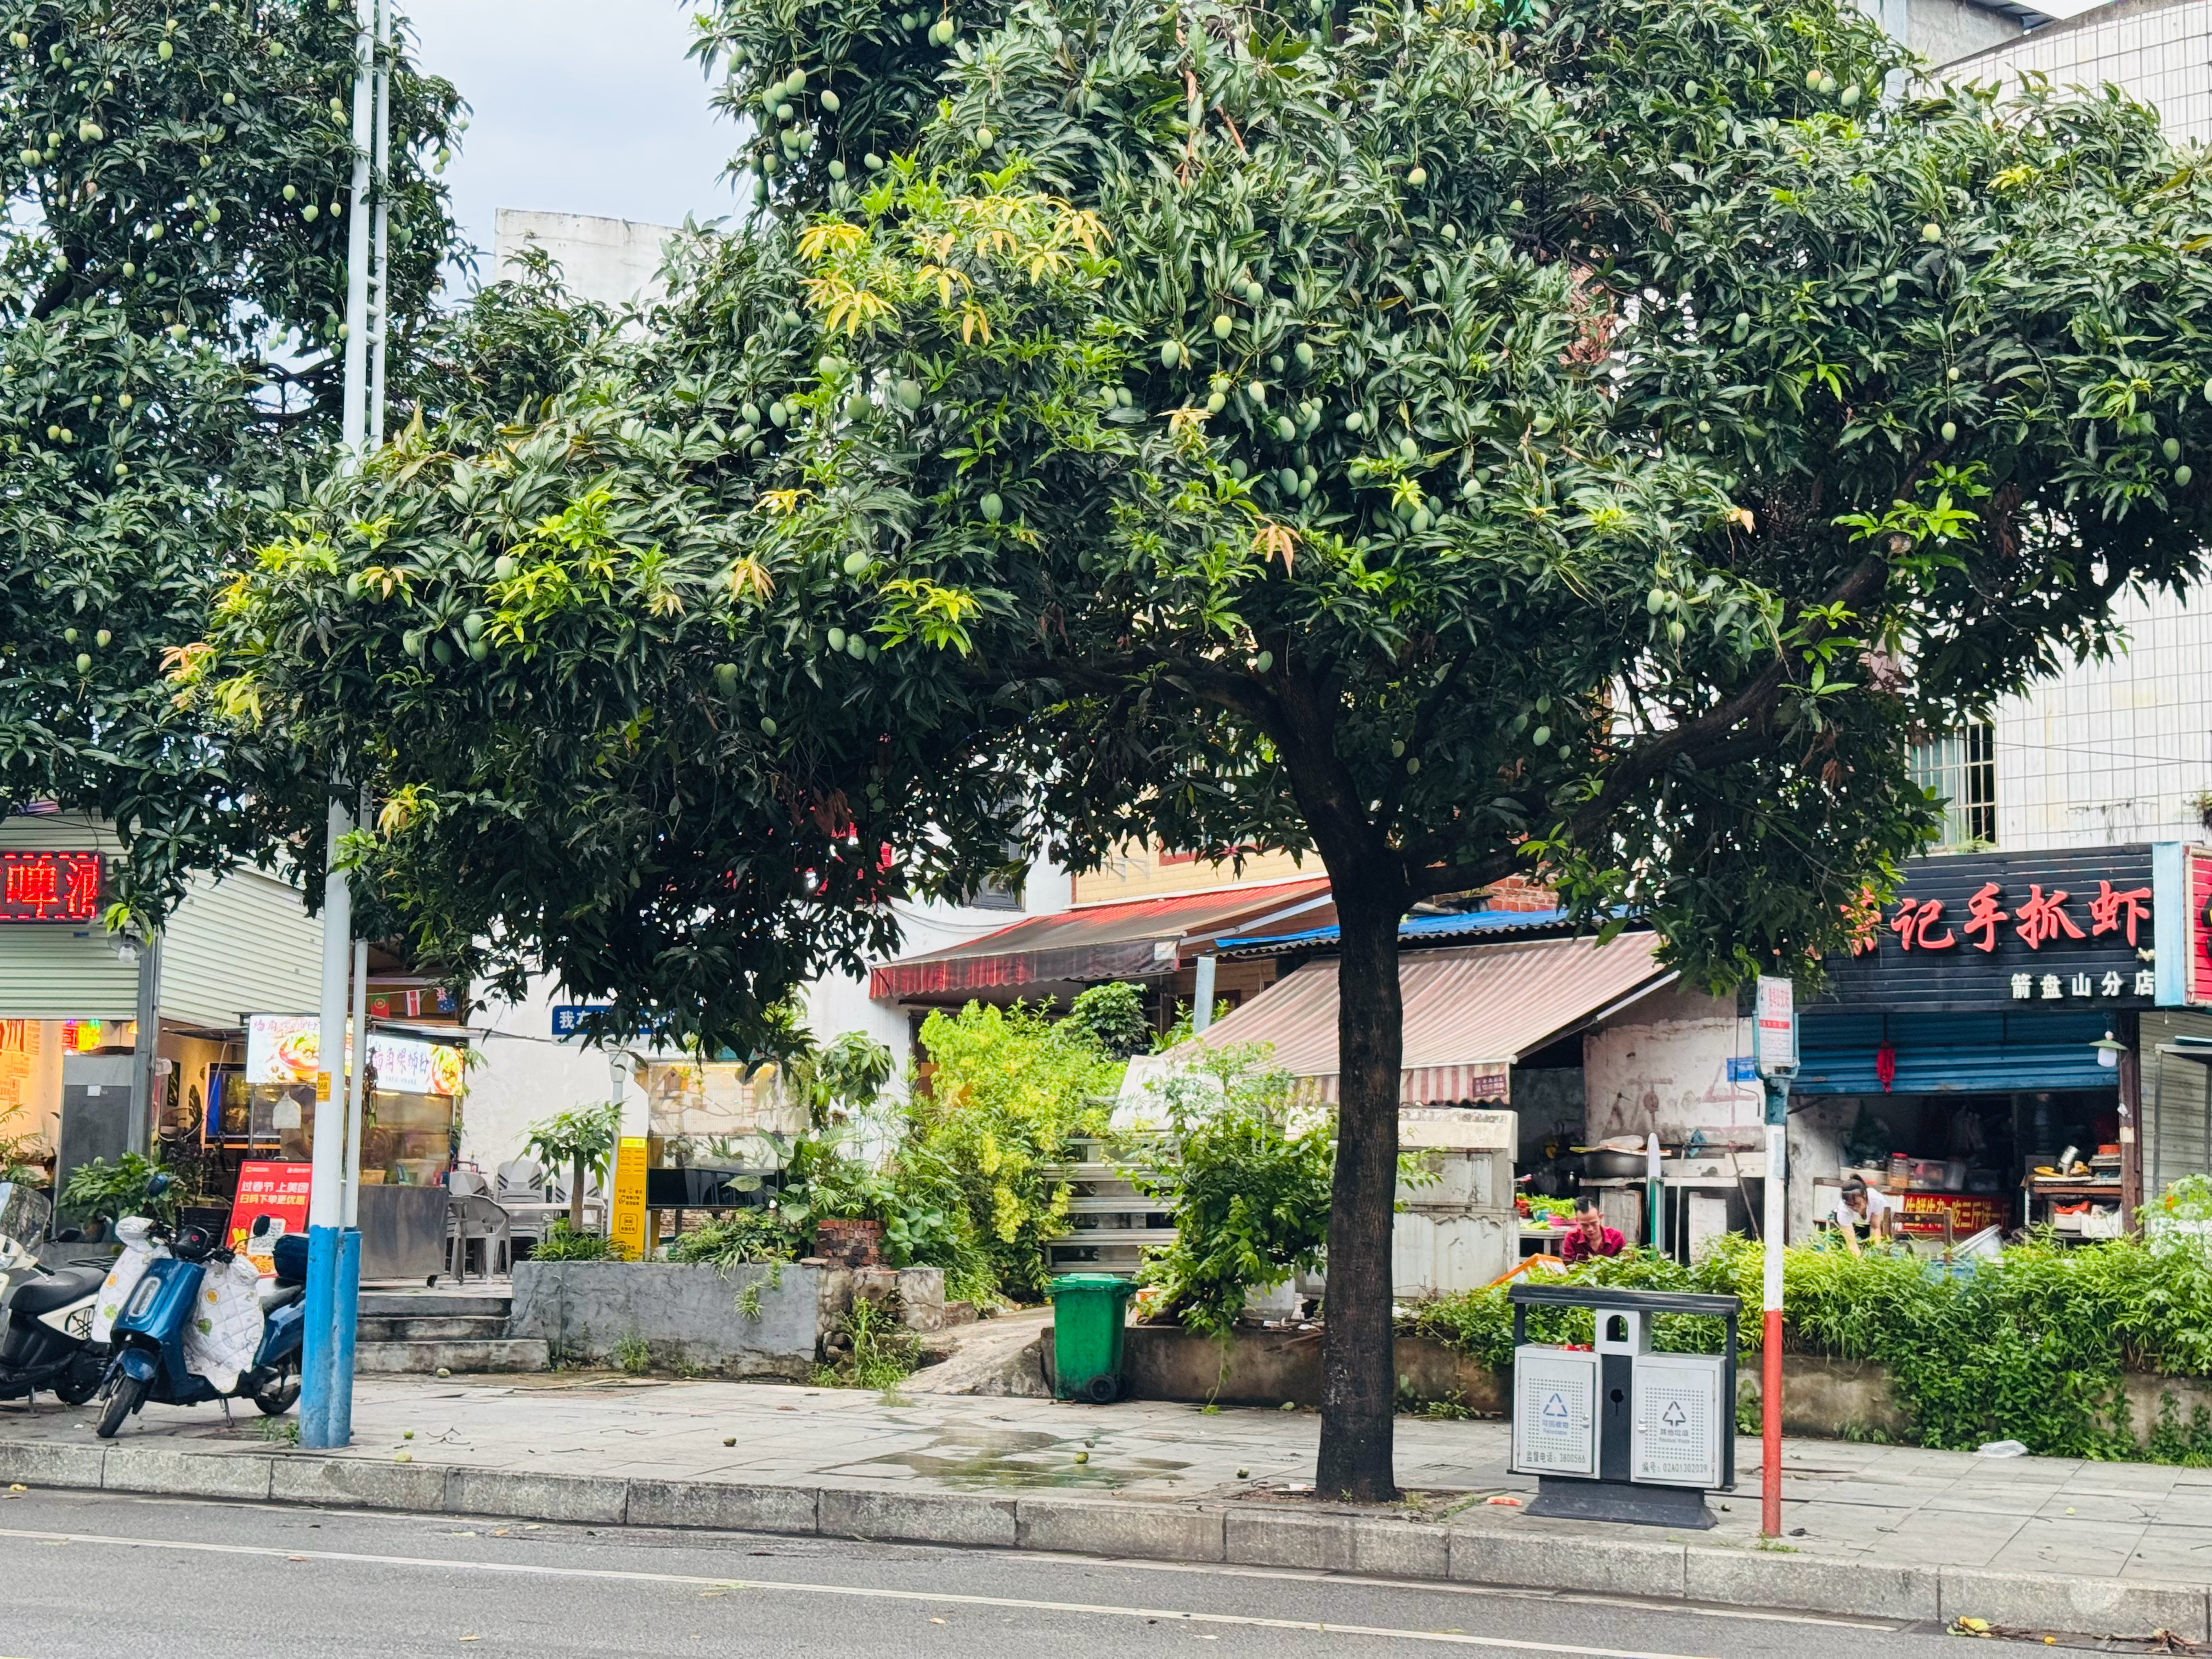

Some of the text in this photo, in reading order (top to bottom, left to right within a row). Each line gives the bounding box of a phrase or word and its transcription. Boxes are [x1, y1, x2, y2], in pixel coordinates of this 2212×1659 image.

[2011, 969, 2155, 1000] 箭盘山分店
[241, 1181, 309, 1193] 过春节 上美团
[240, 1194, 306, 1205] 扫码下单更优惠
[1660, 1428, 1689, 1436] 其他垃圾
